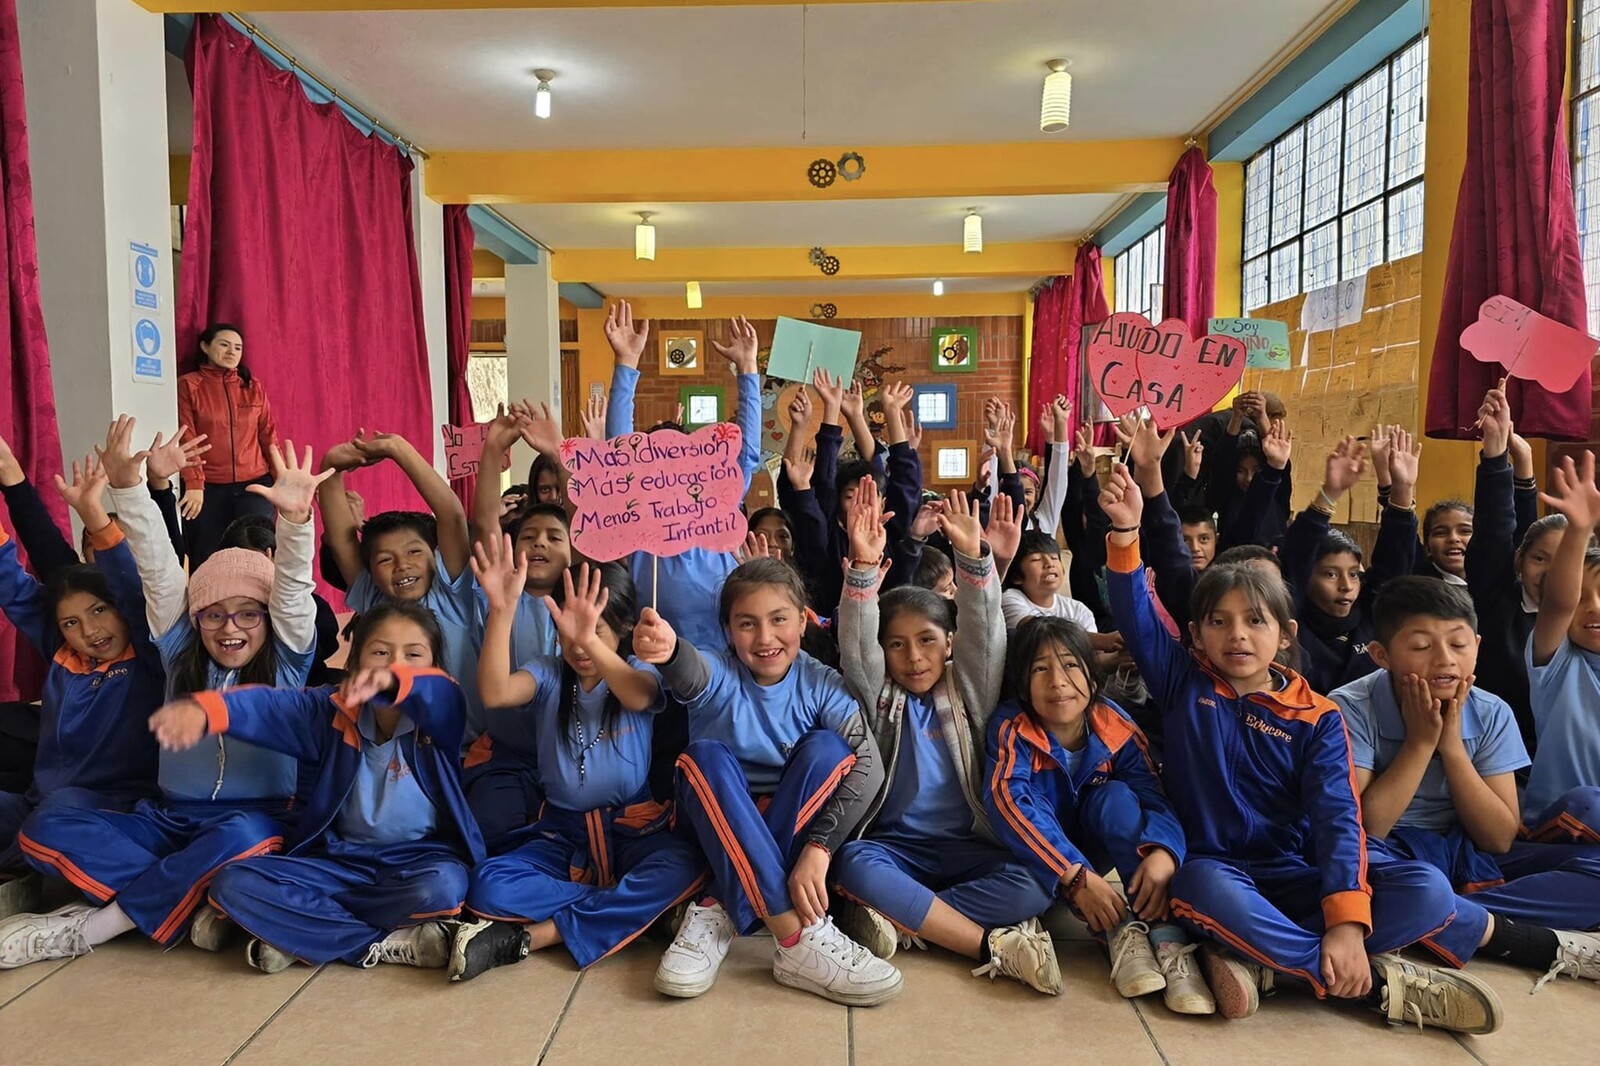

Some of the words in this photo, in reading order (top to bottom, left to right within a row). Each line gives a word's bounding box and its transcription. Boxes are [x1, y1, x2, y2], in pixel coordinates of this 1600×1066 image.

[1093, 314, 1183, 359] AYUDO
[1198, 338, 1238, 367] EN
[1232, 319, 1259, 337] Soy
[1101, 361, 1184, 412] CASA
[638, 434, 729, 464] diversión
[576, 471, 630, 497] Más
[641, 459, 738, 491] educación
[580, 510, 641, 532] Menos
[649, 497, 718, 520] Trabajo
[662, 512, 737, 542] Infantil
[1245, 712, 1292, 743] Educare
